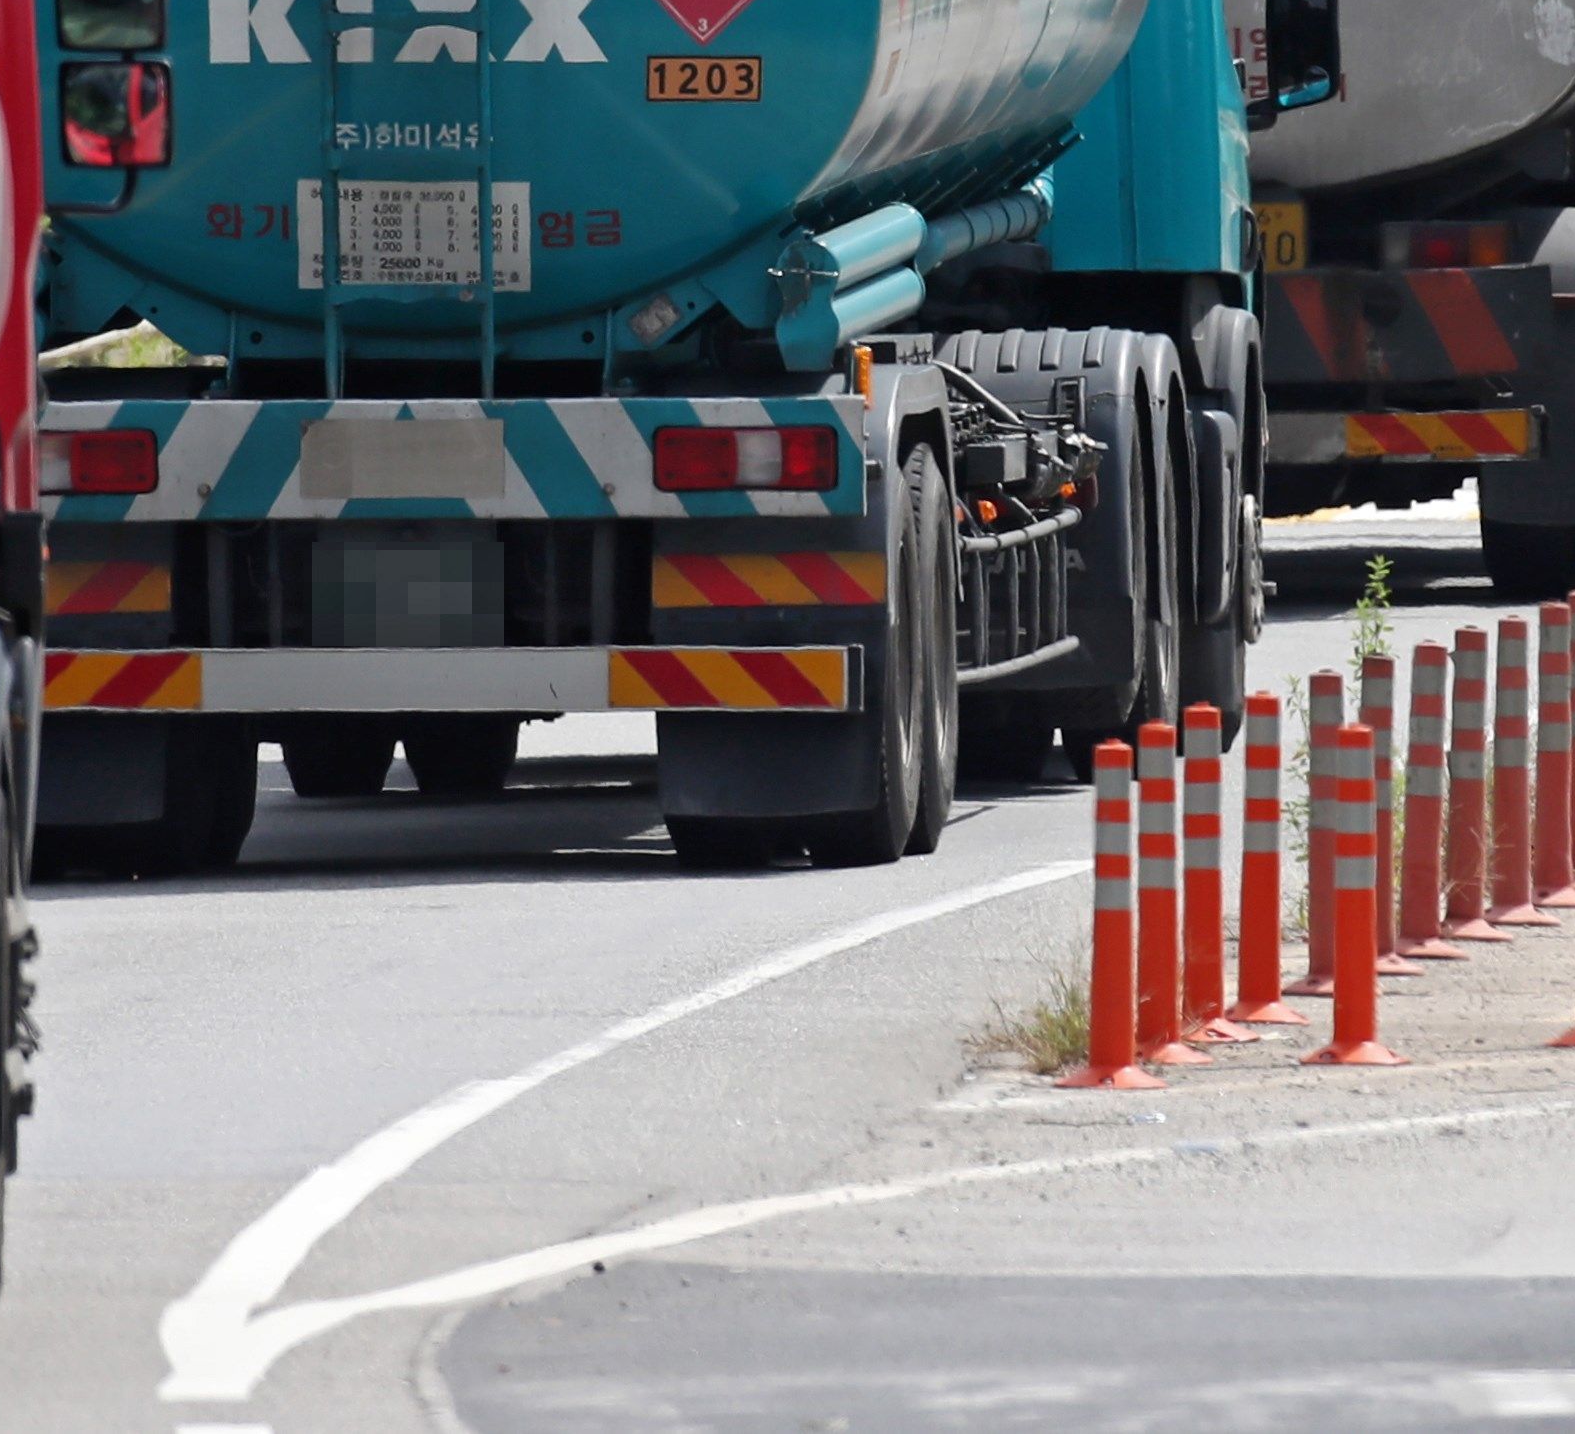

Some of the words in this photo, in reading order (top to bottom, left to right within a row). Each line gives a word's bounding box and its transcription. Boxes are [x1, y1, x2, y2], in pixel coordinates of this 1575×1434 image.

[696, 19, 709, 35] 3
[652, 62, 757, 97] 1203
[206, 203, 291, 242] 화기
[538, 209, 623, 249] 엄금
